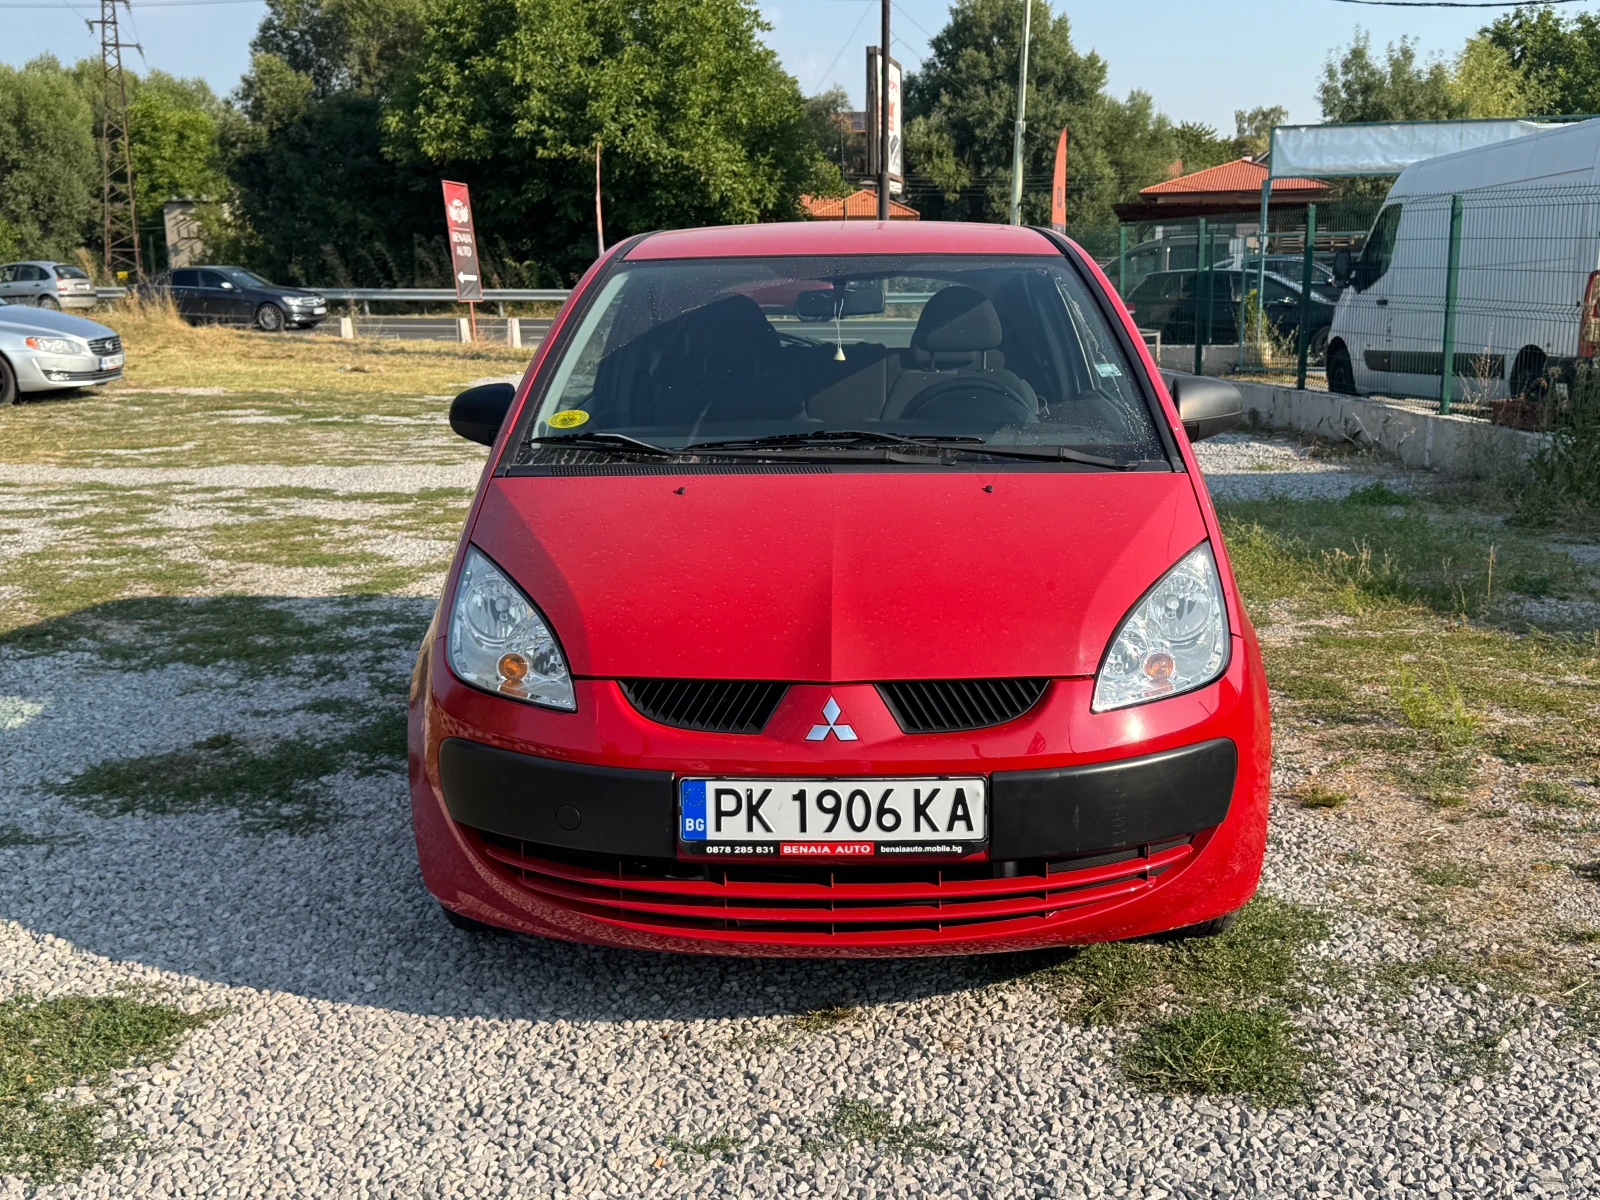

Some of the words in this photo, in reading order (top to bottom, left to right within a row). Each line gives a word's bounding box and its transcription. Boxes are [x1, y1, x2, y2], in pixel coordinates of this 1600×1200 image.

[456, 245, 472, 257] AUTO
[714, 788, 775, 833] PK
[792, 788, 902, 833] 1906
[913, 787, 974, 833] KA
[685, 818, 705, 832] BG
[706, 845, 732, 854] 0878
[734, 845, 754, 854] 285
[755, 845, 775, 854] 831
[783, 845, 831, 854] BENAIA
[835, 845, 871, 854] AUTO
[880, 844, 963, 854] benaiaauto.mobile.bg
